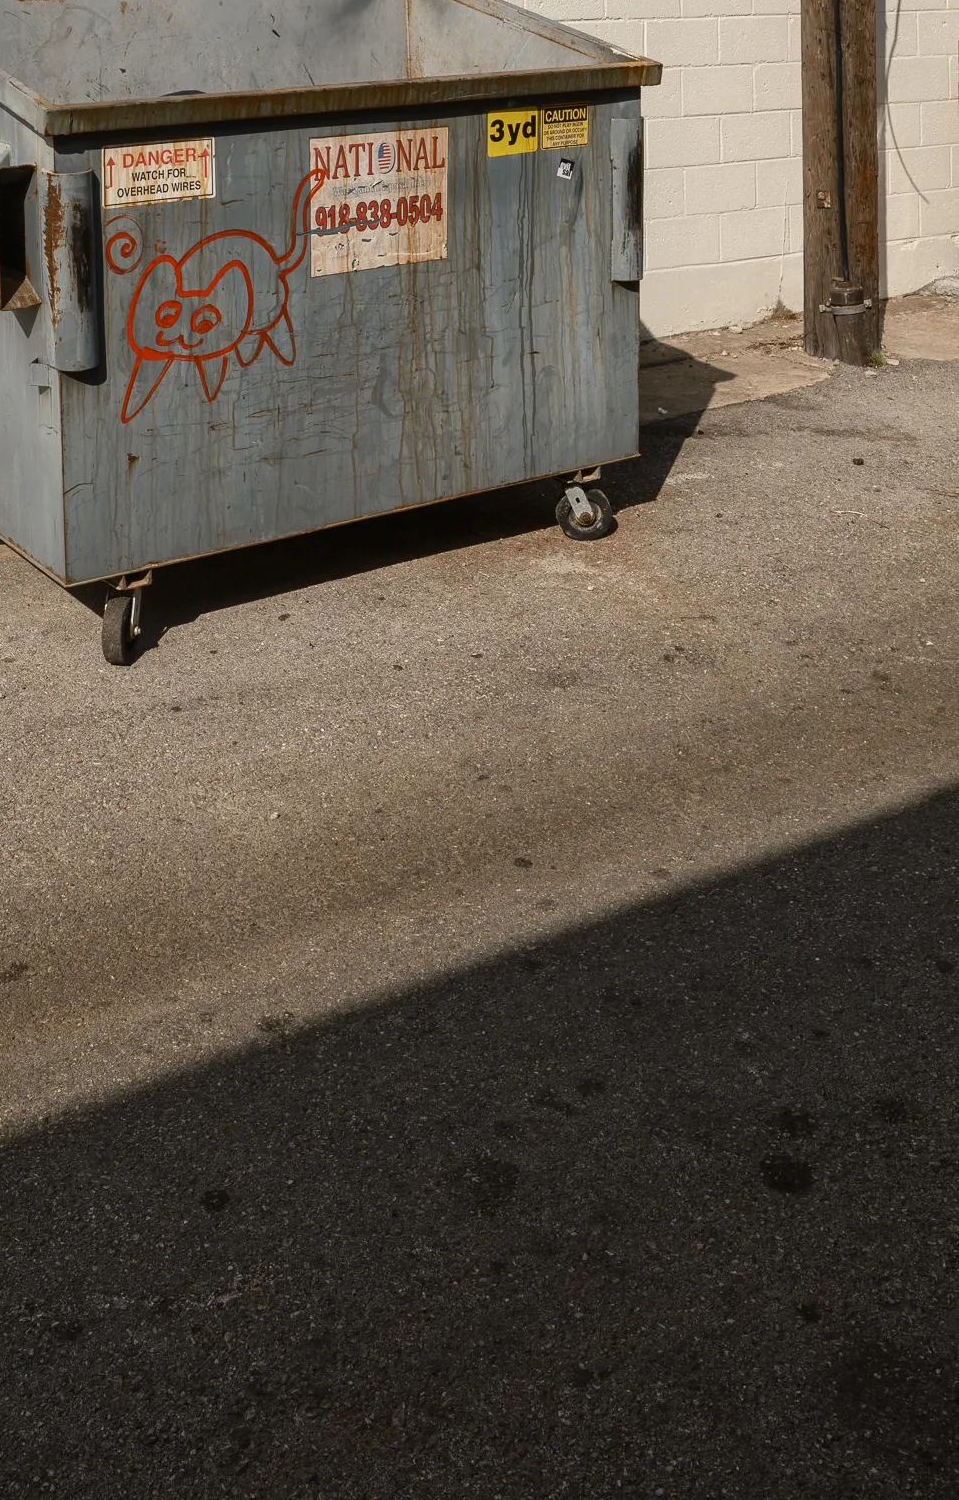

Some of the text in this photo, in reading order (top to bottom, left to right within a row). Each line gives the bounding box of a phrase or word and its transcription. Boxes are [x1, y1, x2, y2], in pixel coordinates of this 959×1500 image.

[545, 107, 586, 123] CAUTION
[489, 115, 536, 146] 3yd
[123, 147, 197, 168] DANGER
[313, 136, 445, 181] NATIONAL
[132, 168, 186, 182] WATCH FOR
[117, 180, 201, 198] OVERHEAD WIRES
[315, 192, 444, 237] 918-838-0504
